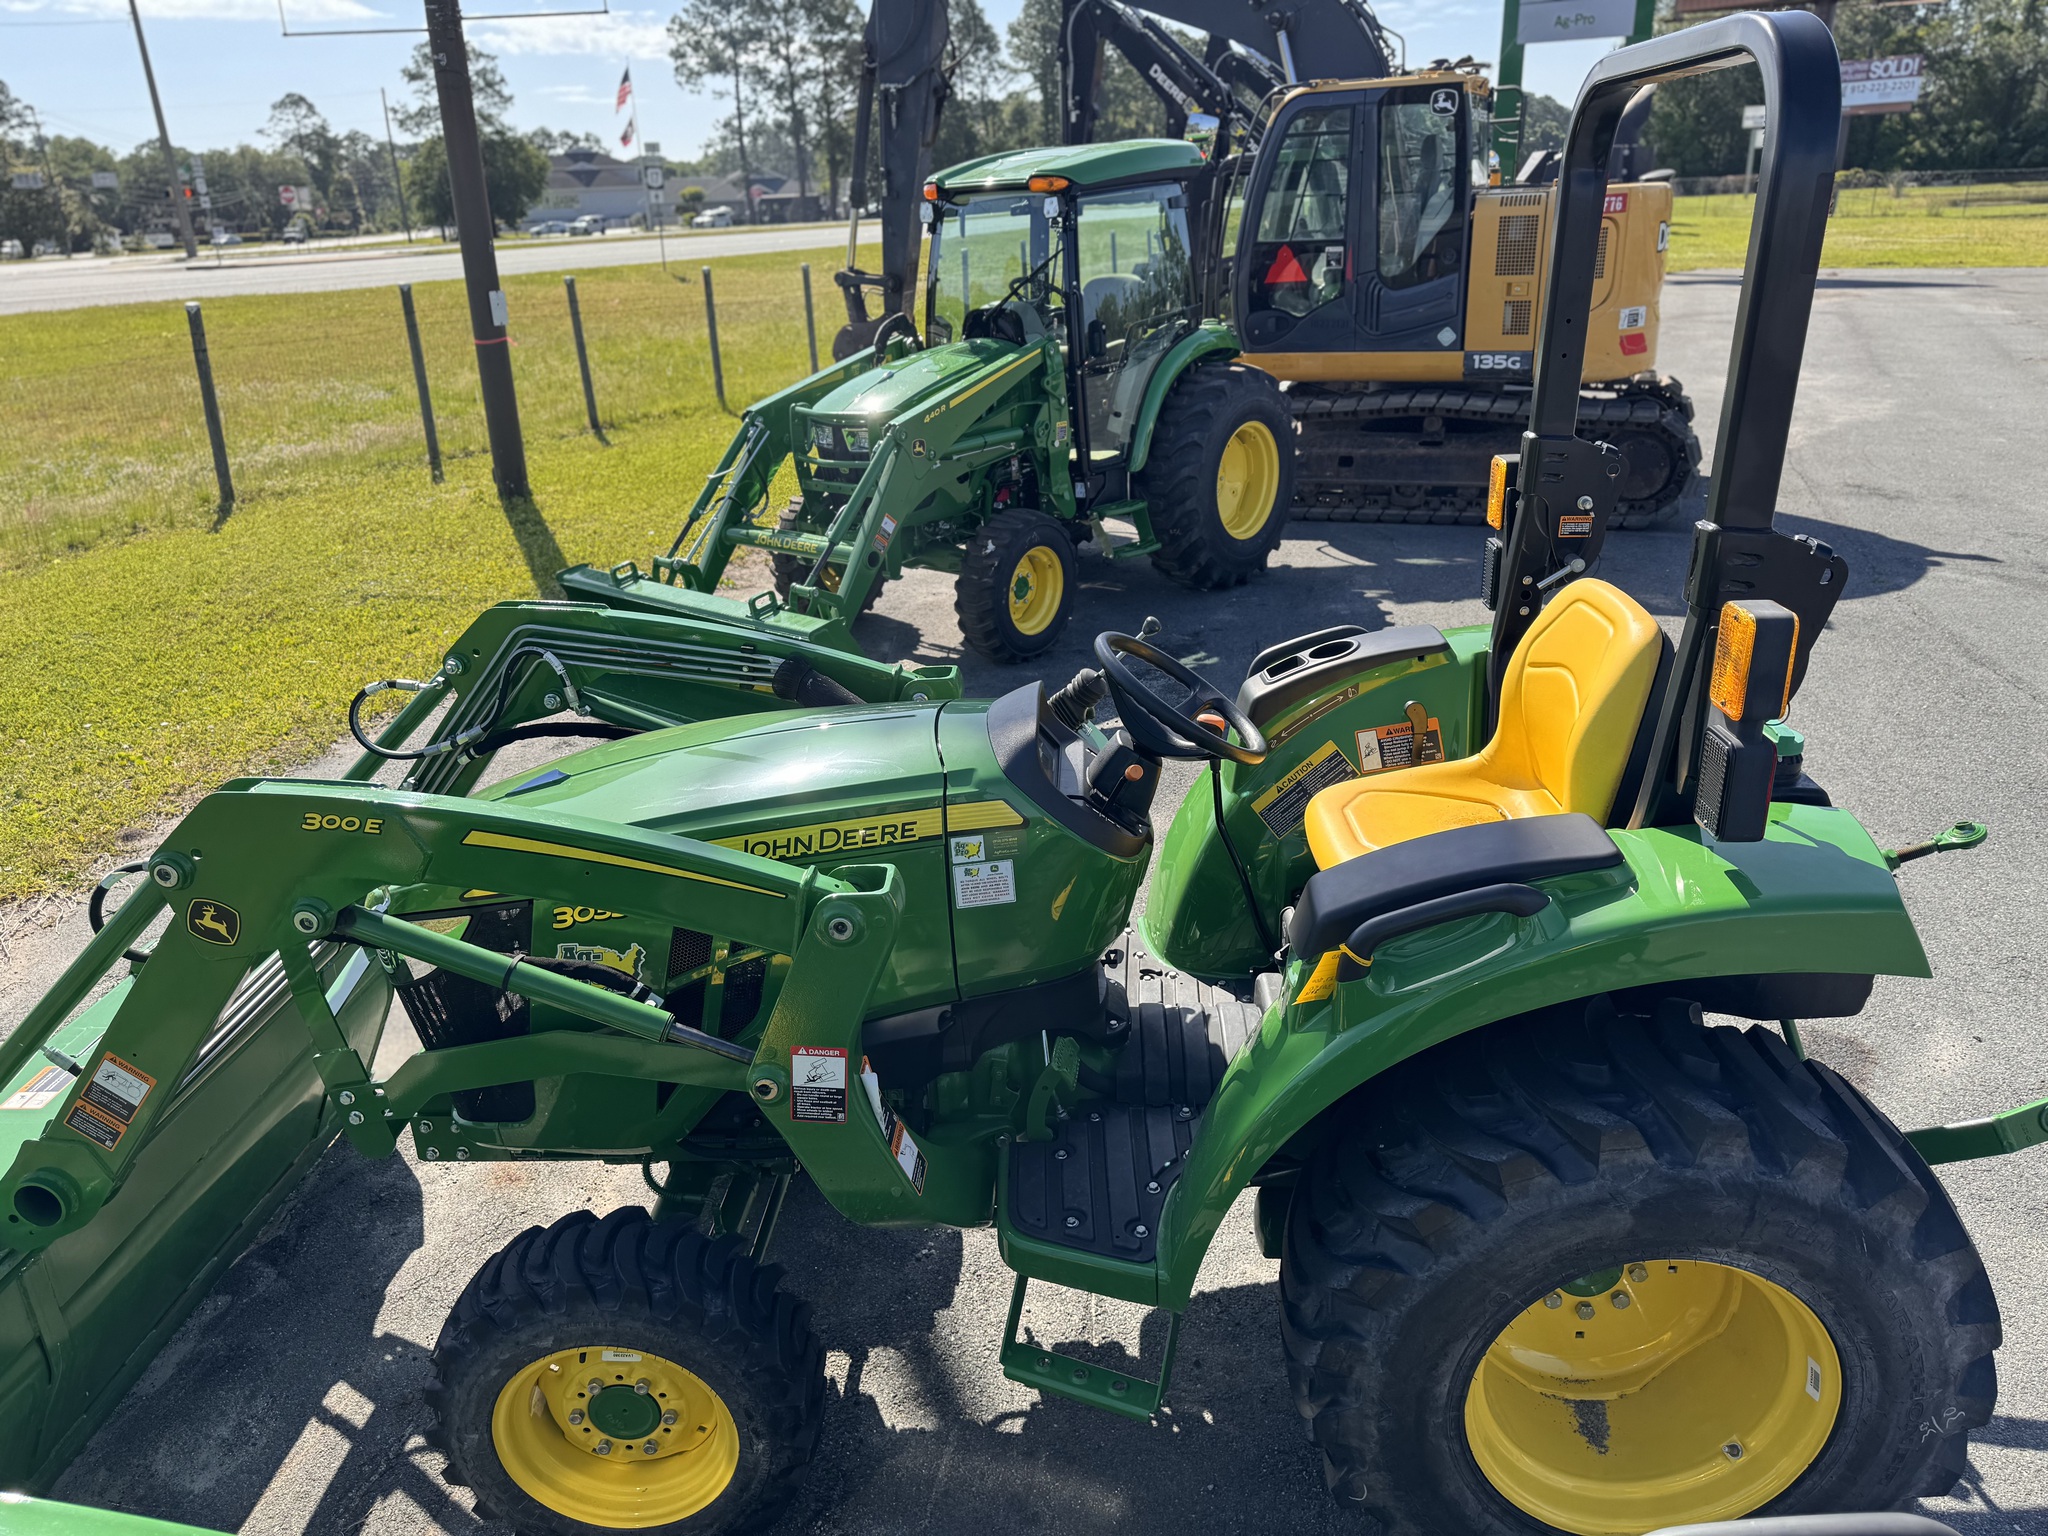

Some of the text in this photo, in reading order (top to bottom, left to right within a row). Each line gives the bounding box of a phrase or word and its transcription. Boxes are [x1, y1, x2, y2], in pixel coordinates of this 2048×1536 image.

[1554, 13, 1595, 30] Ag-Pro
[1869, 57, 1920, 79] SOLD!
[1149, 63, 1188, 105] DEERE
[1850, 80, 1916, 94] 912-223-2201
[1472, 354, 1521, 370] 135G
[924, 404, 946, 423] 440 R
[754, 532, 819, 554] JOHN DEERE
[1282, 760, 1314, 789] CAUTION
[301, 812, 385, 835] 300 E
[743, 820, 918, 859] JOHN DEERE
[118, 1060, 150, 1082] WARNING
[89, 1108, 120, 1130] WARNING
